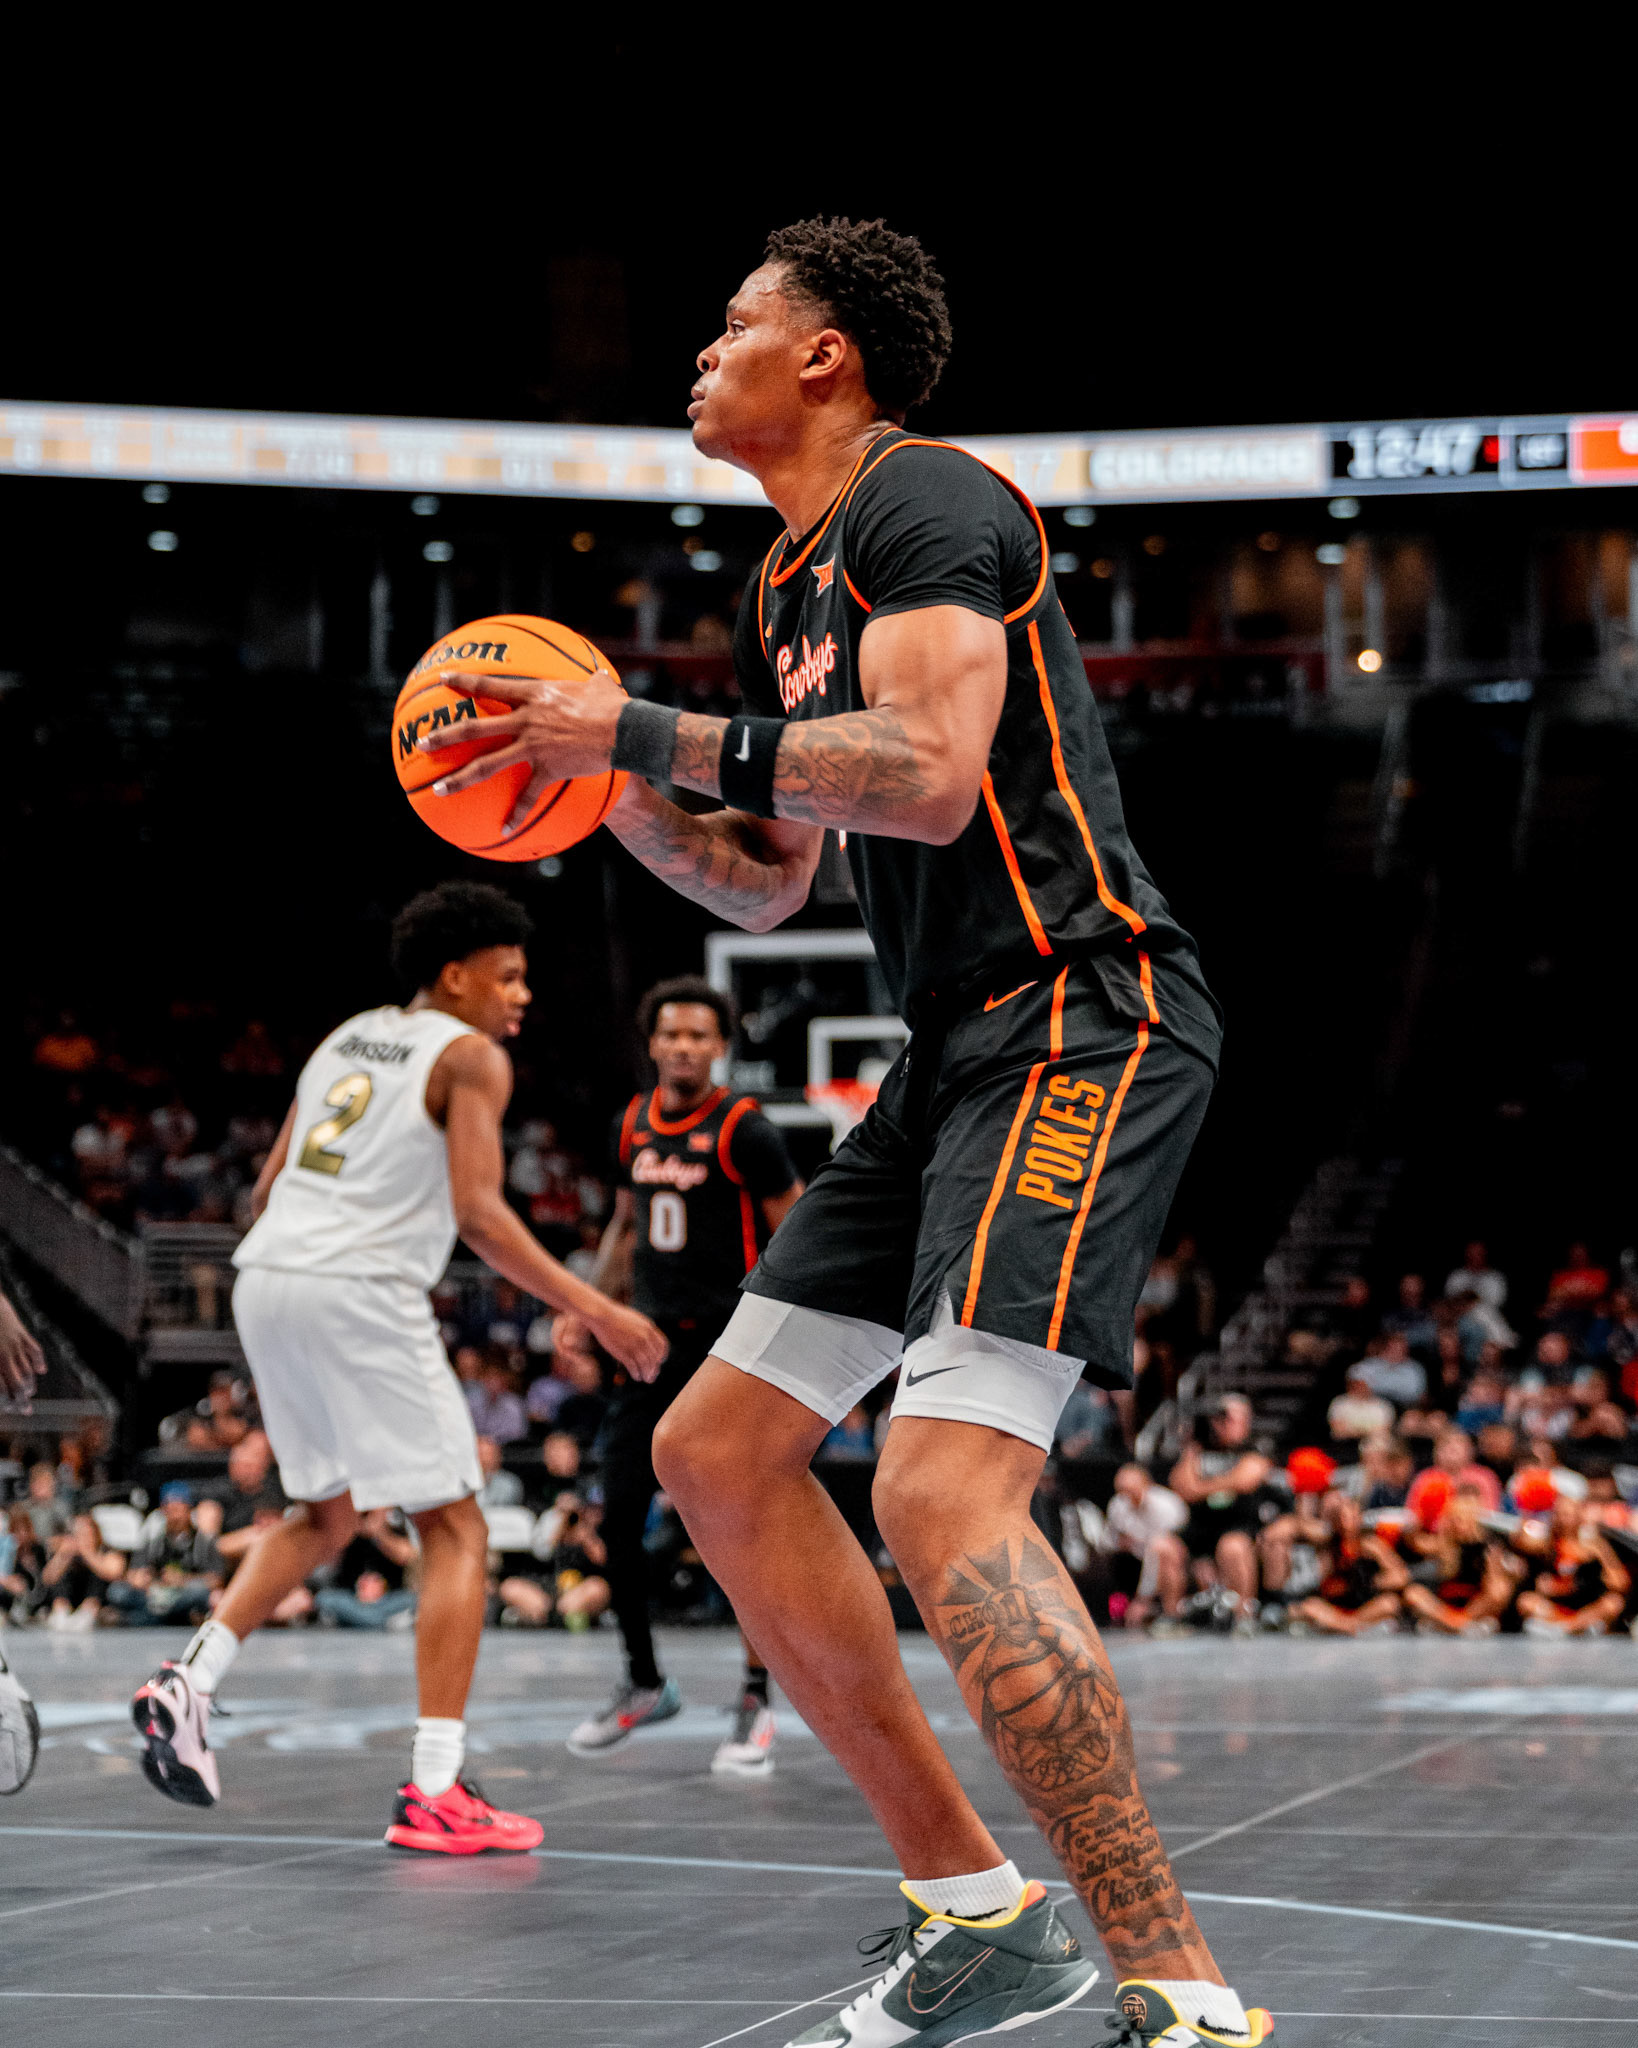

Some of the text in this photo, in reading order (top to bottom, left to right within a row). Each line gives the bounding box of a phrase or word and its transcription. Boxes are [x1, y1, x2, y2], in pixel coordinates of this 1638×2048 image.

[299, 1071, 373, 1176] 2
[1016, 1074, 1106, 1210] POKES
[650, 1191, 688, 1252] 0
